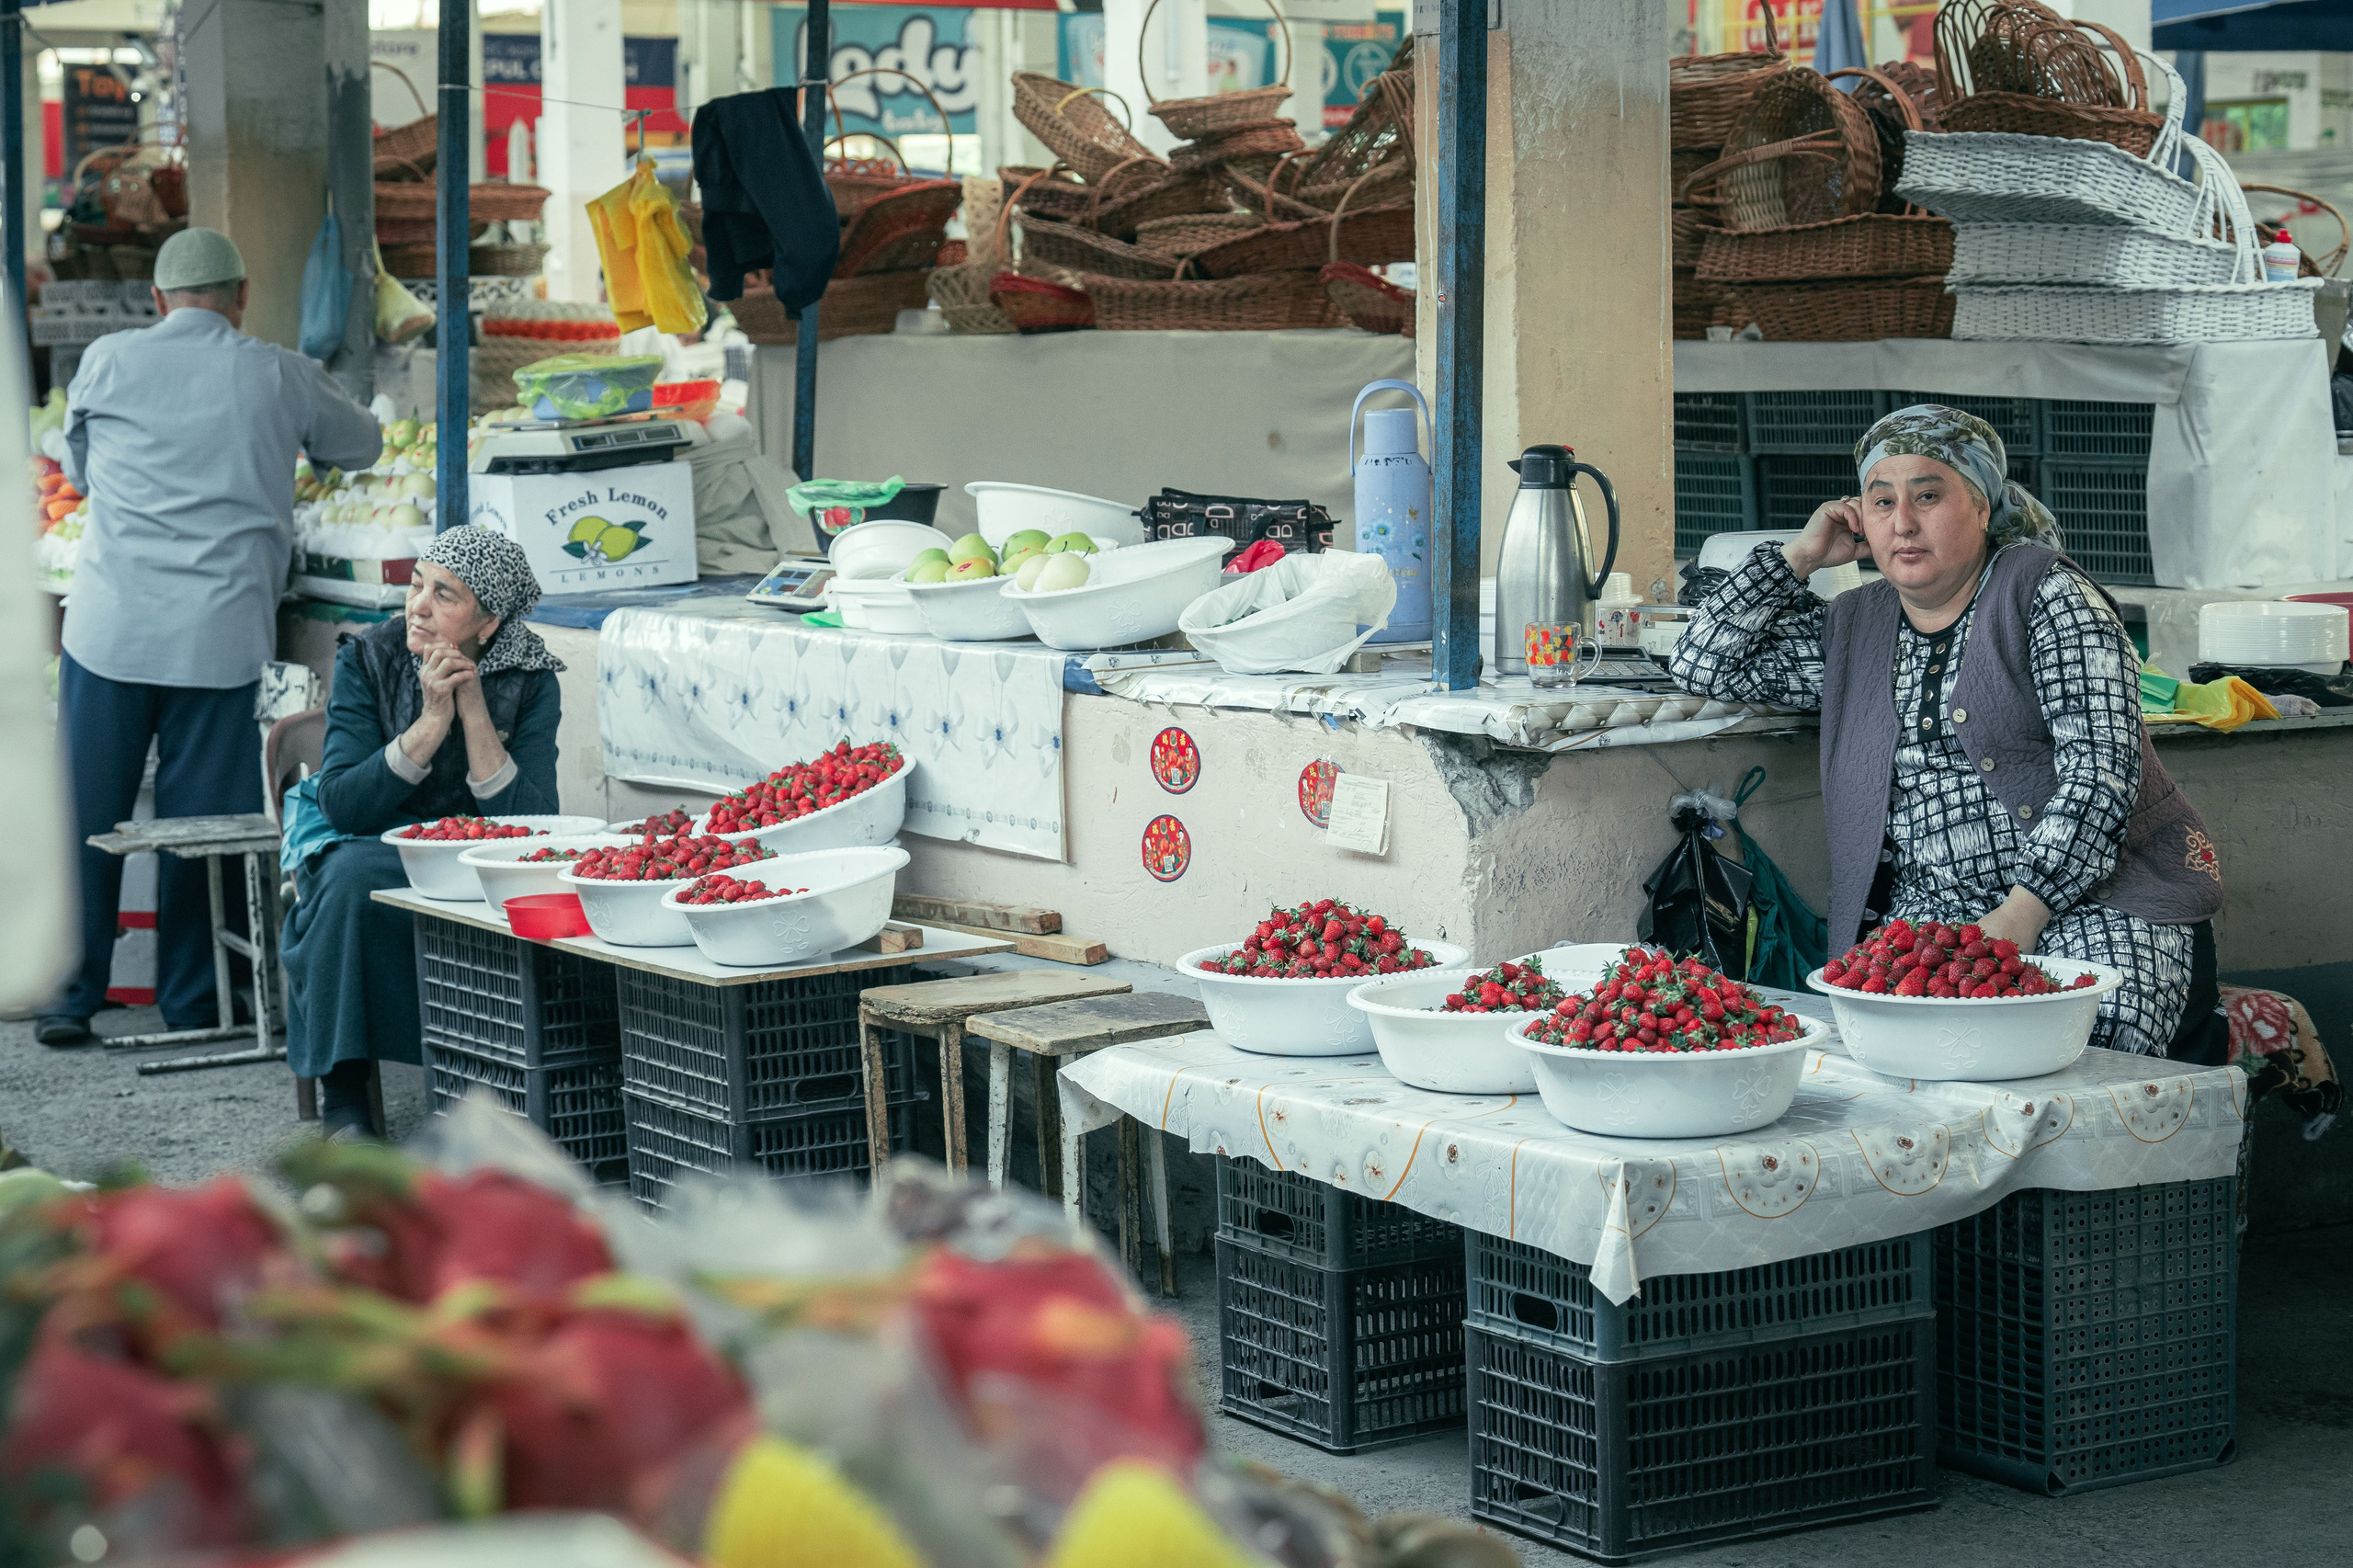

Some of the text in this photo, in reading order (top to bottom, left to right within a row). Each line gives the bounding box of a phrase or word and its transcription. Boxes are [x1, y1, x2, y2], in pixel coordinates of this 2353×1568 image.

[544, 487, 669, 526] Fresh Lemon
[561, 565, 661, 584] LEMONS
